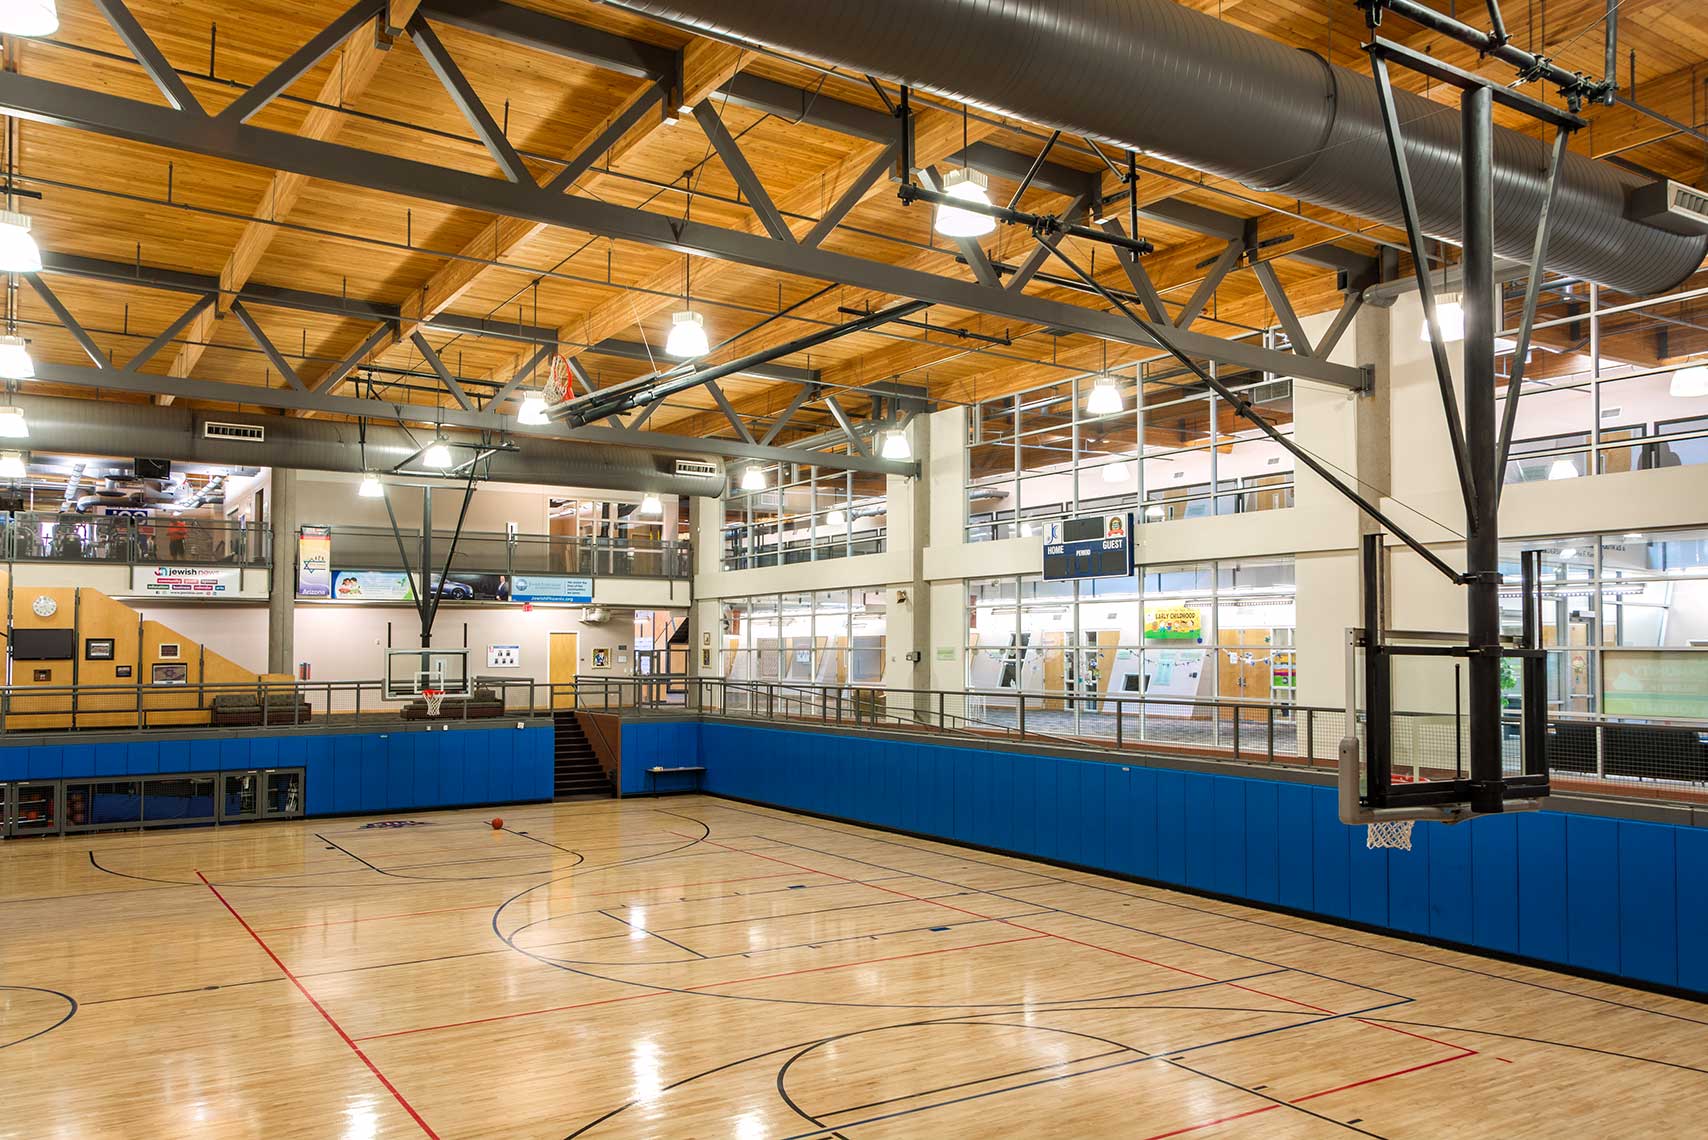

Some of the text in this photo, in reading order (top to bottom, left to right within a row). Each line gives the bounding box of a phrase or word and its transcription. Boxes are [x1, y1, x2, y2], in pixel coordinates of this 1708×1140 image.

[1102, 539, 1123, 549] GUEST
[1047, 545, 1064, 555] HOME
[169, 568, 197, 577] jewish
[1170, 612, 1196, 620] CHILDHOOD
